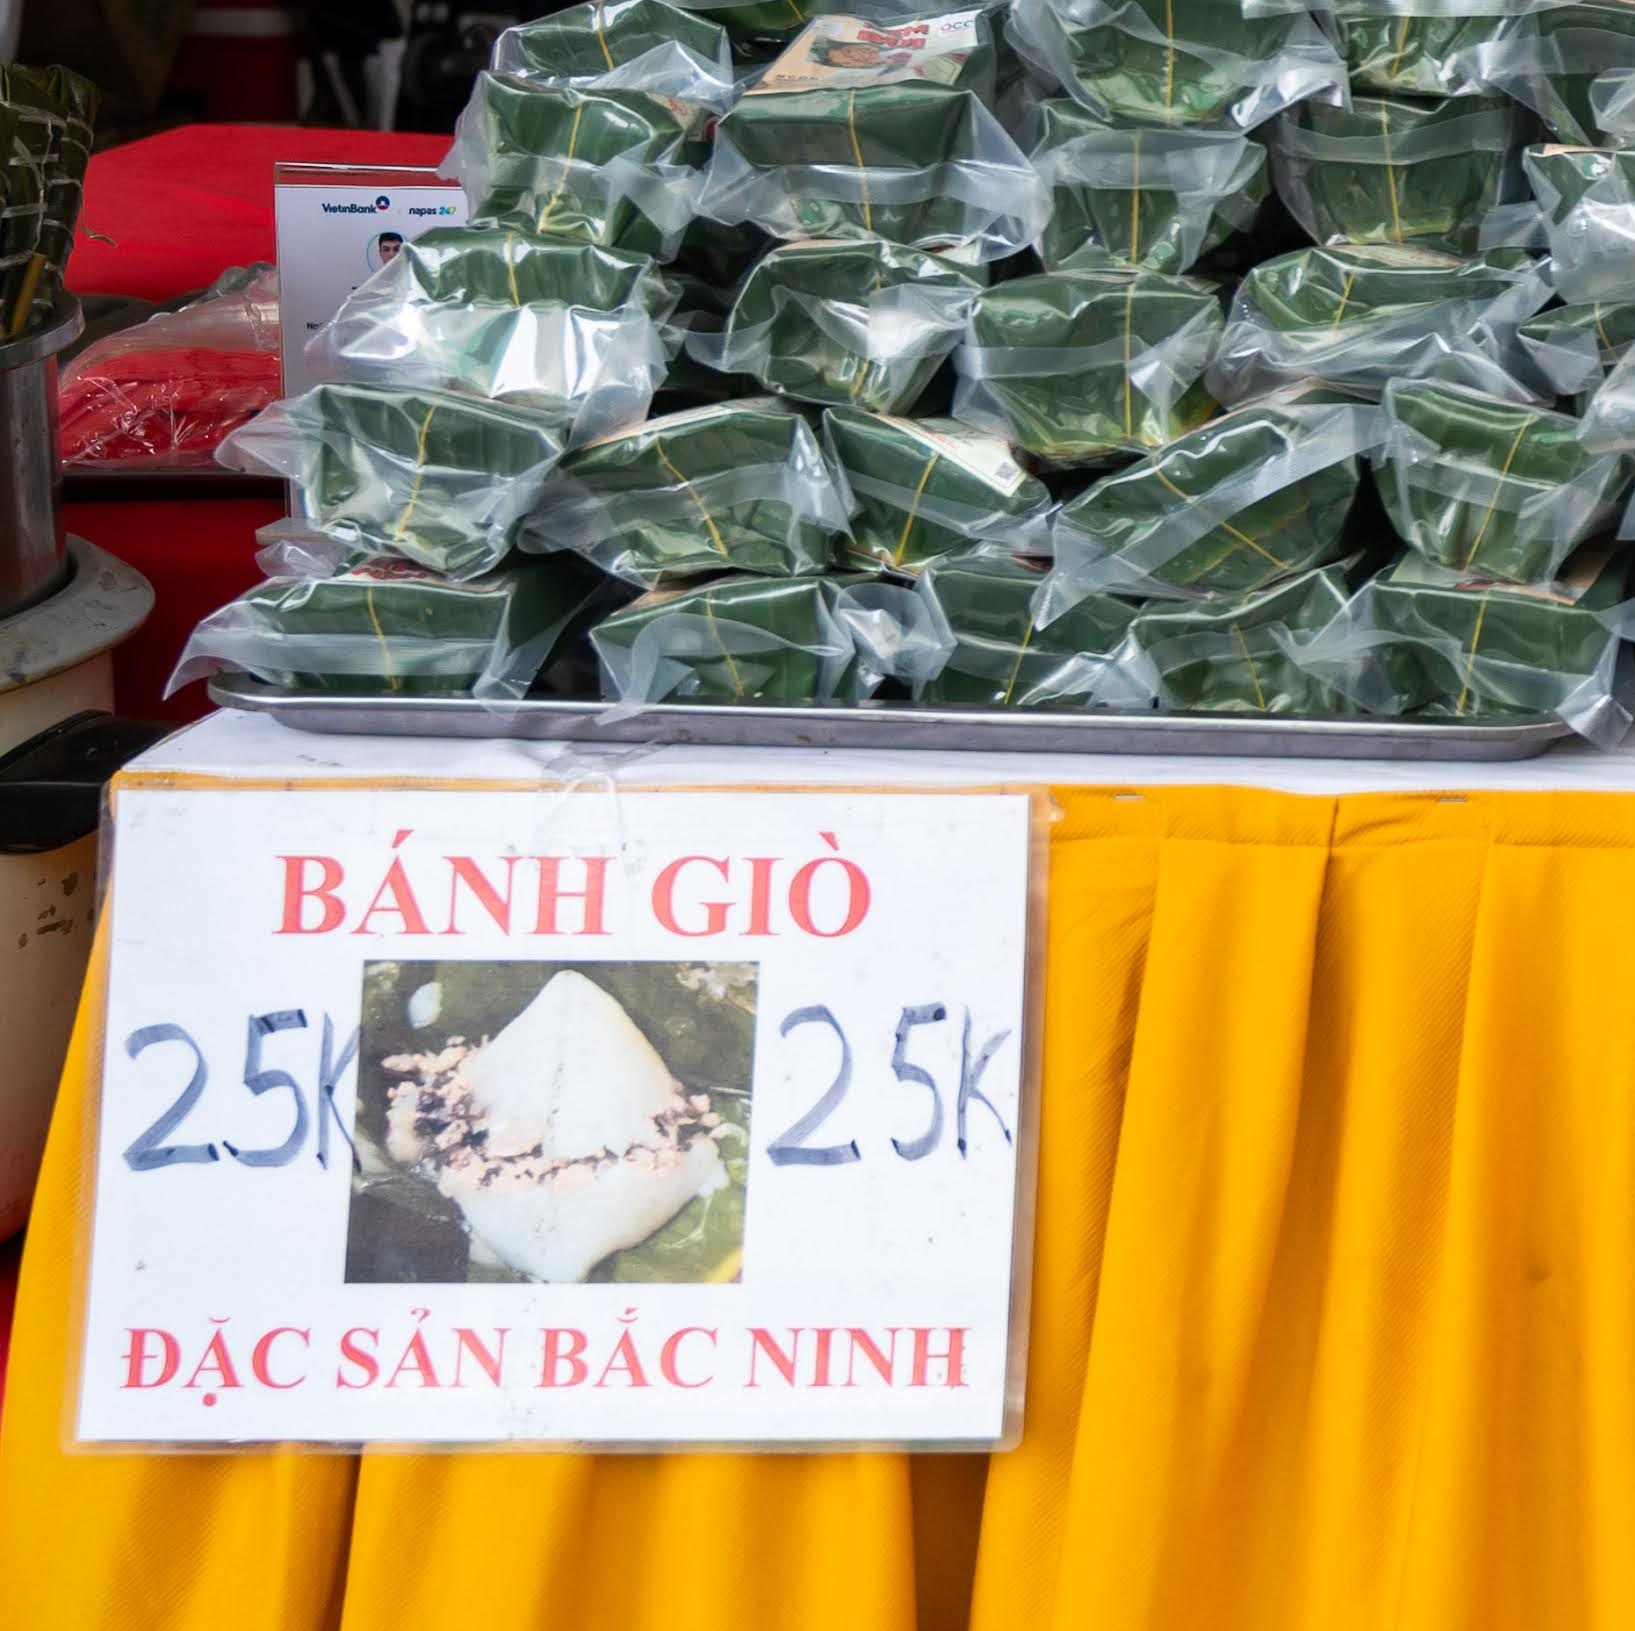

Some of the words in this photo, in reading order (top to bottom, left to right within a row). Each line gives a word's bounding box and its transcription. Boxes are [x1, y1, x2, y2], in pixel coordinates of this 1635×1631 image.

[321, 202, 378, 215] VietinBank
[408, 207, 437, 217] napas
[438, 206, 457, 216] 247
[273, 829, 615, 936] BÁNH
[650, 832, 873, 939] GIÒ
[122, 1009, 362, 1173] 25K
[765, 1002, 1013, 1167] 25K
[120, 1317, 311, 1408] ĐẶC
[335, 1306, 506, 1390] SẢN
[538, 1306, 721, 1392] BẮC
[745, 1325, 970, 1392] NINH
